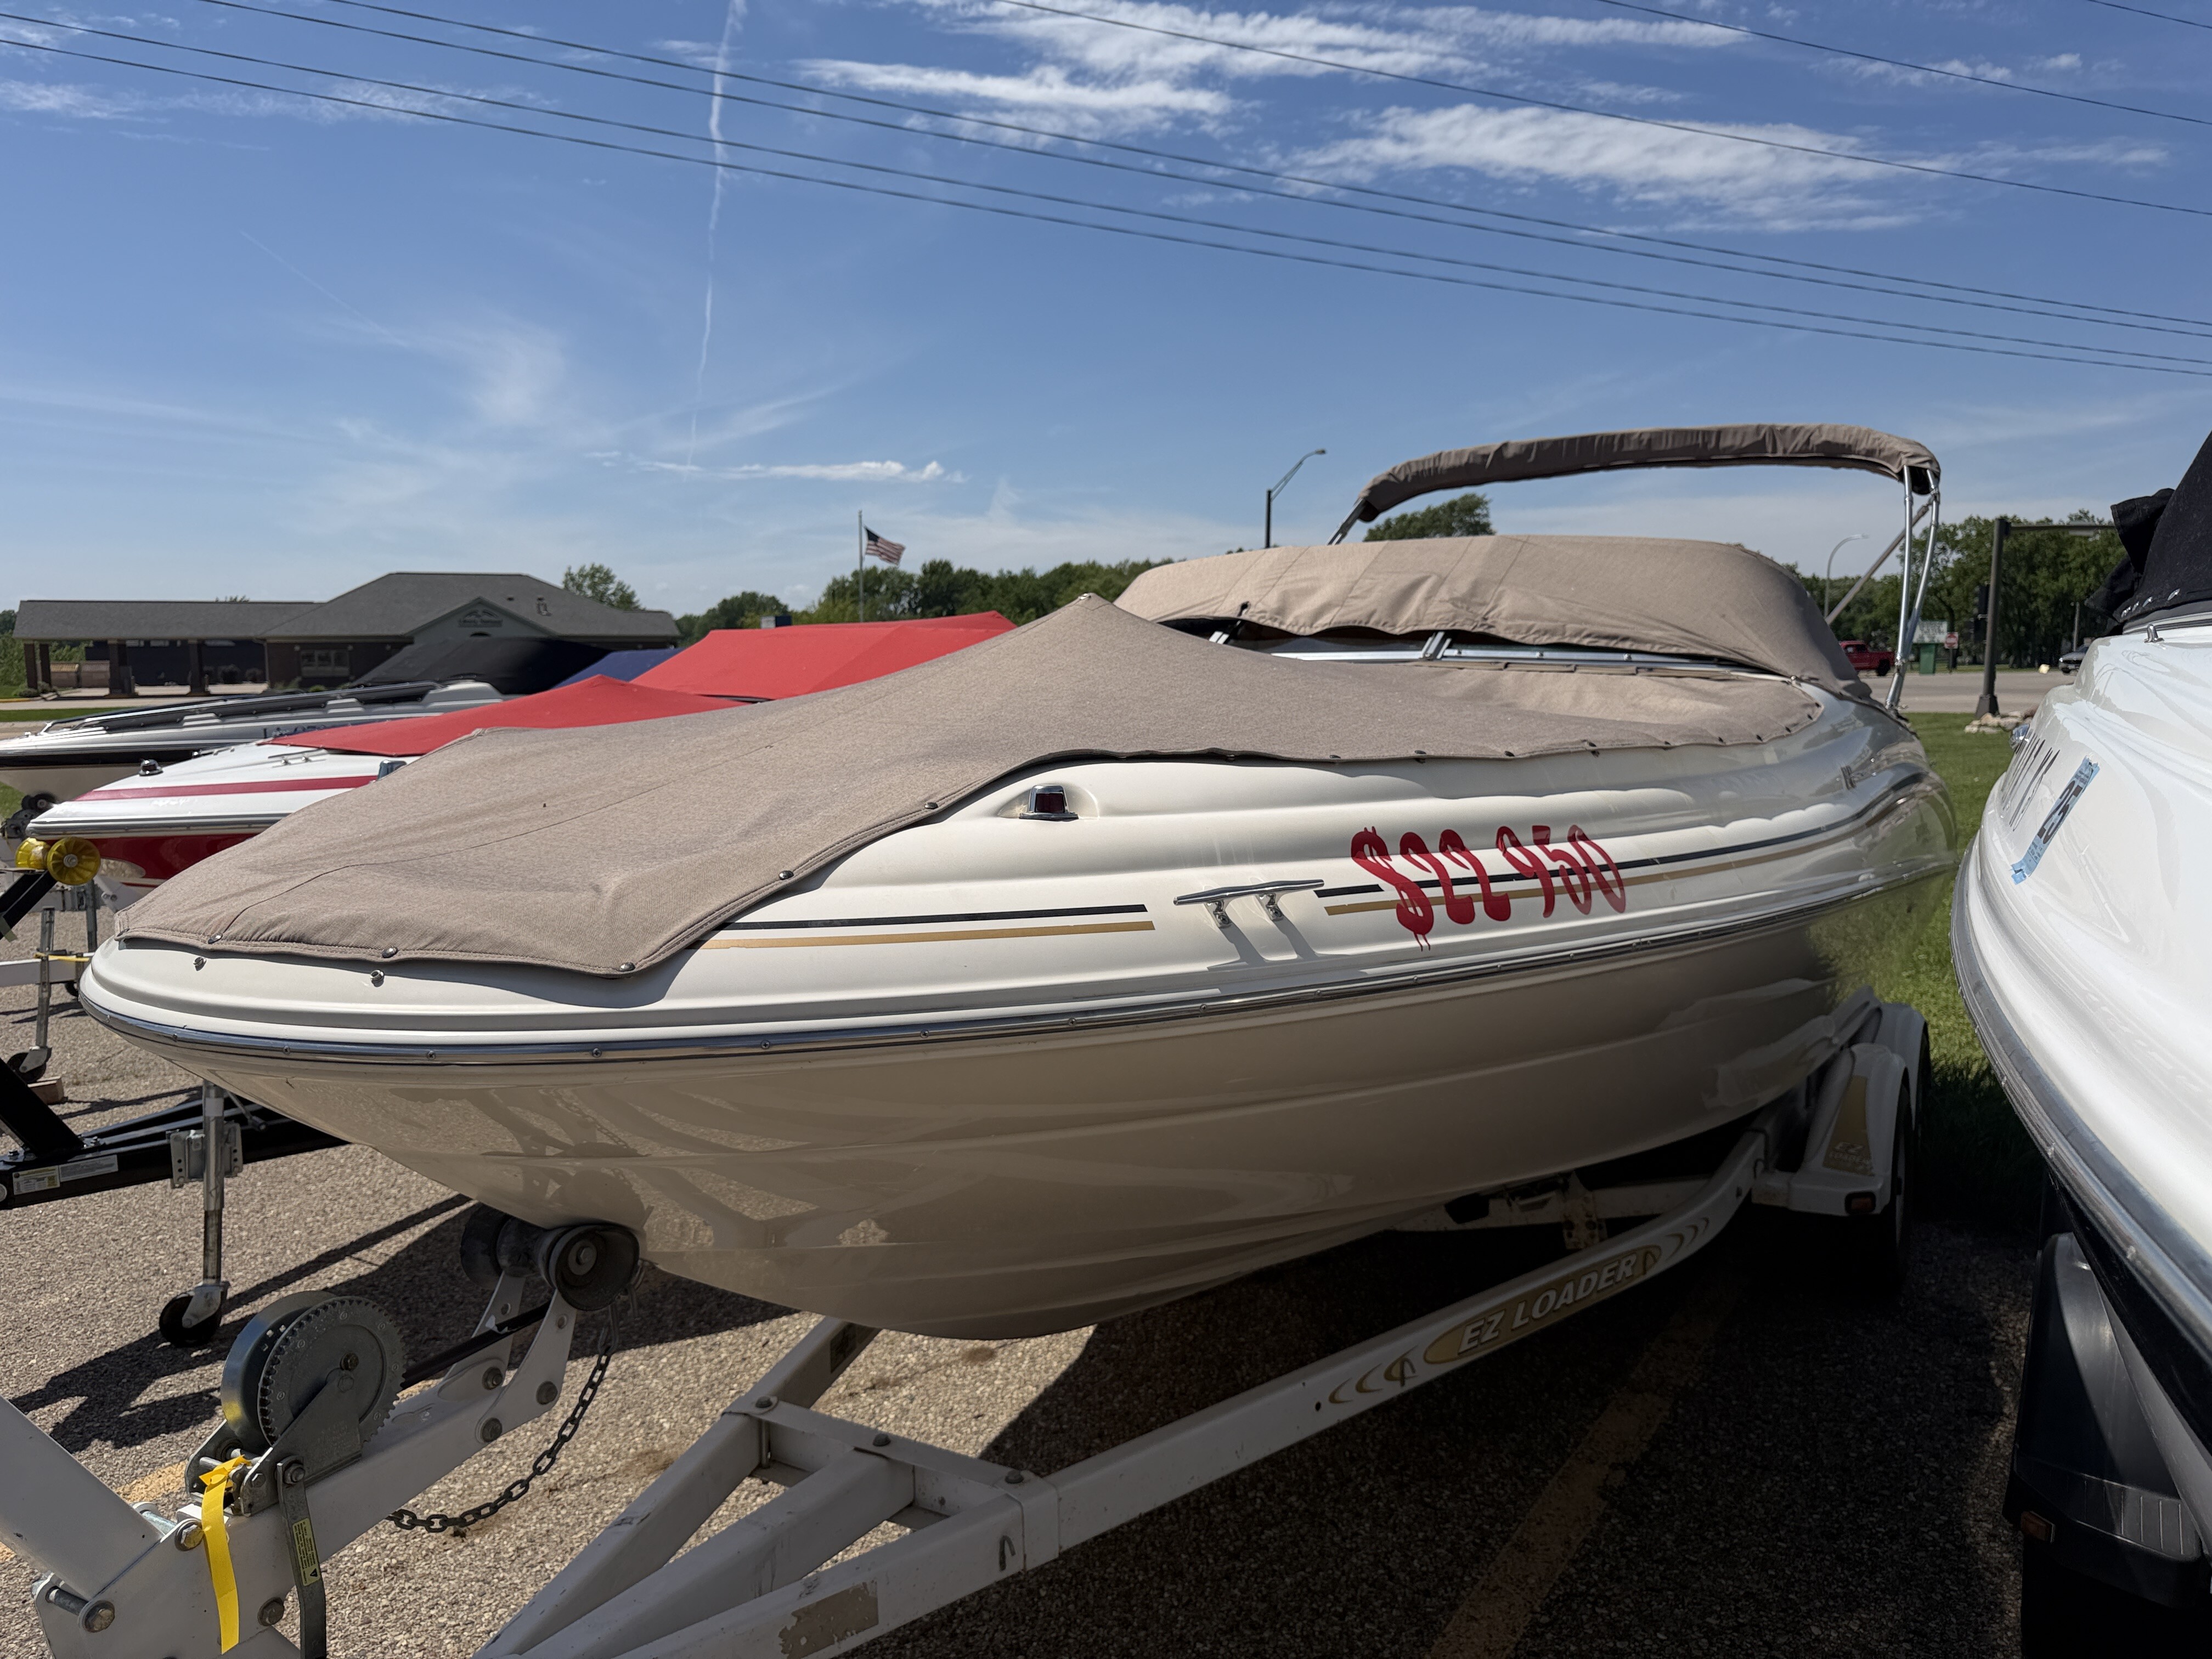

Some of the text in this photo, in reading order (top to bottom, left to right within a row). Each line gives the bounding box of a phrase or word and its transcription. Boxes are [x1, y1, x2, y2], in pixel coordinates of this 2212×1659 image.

[2037, 780, 2083, 844] 25
[1457, 1253, 1637, 1355] EZ LOADER
